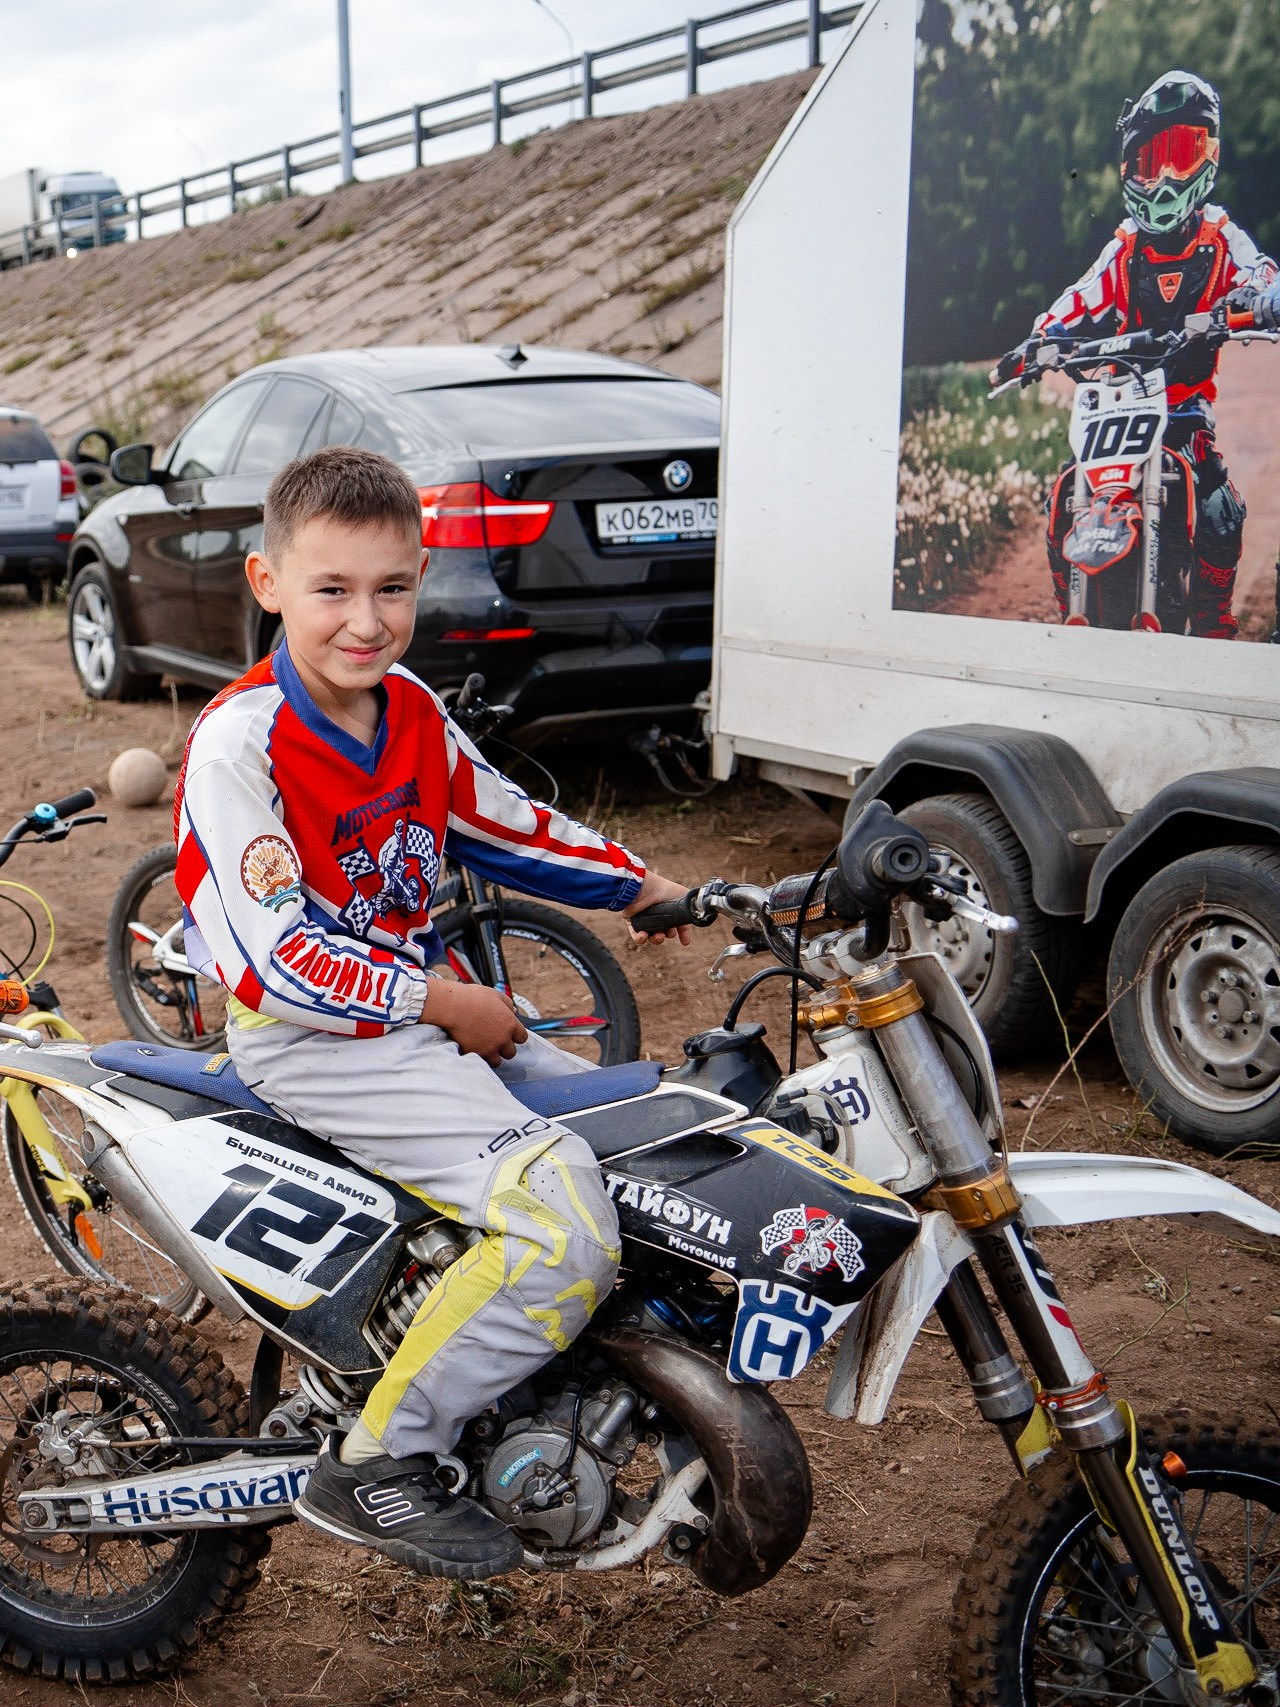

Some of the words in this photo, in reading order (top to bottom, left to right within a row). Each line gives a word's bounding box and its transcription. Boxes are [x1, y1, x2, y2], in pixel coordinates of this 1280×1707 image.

[1098, 338, 1132, 355] KTM
[1080, 413, 1161, 463] 109
[1098, 468, 1126, 481] KTM
[331, 777, 420, 846] MOTOCROSS
[276, 930, 389, 1007] ТАЙФУН
[225, 1135, 320, 1182] Бурашев
[322, 1174, 378, 1207] Амир
[771, 1133, 860, 1182] TC65
[190, 1163, 392, 1293] 121
[604, 1174, 734, 1247] ТАЙФУН
[668, 1234, 737, 1270] Мотоклуб
[987, 1234, 1014, 1270] AER
[1007, 1273, 1028, 1294] 35
[506, 1448, 538, 1478] MOTOREX
[103, 1463, 312, 1524] Husqvar
[1138, 1467, 1220, 1631] DUNLOP
